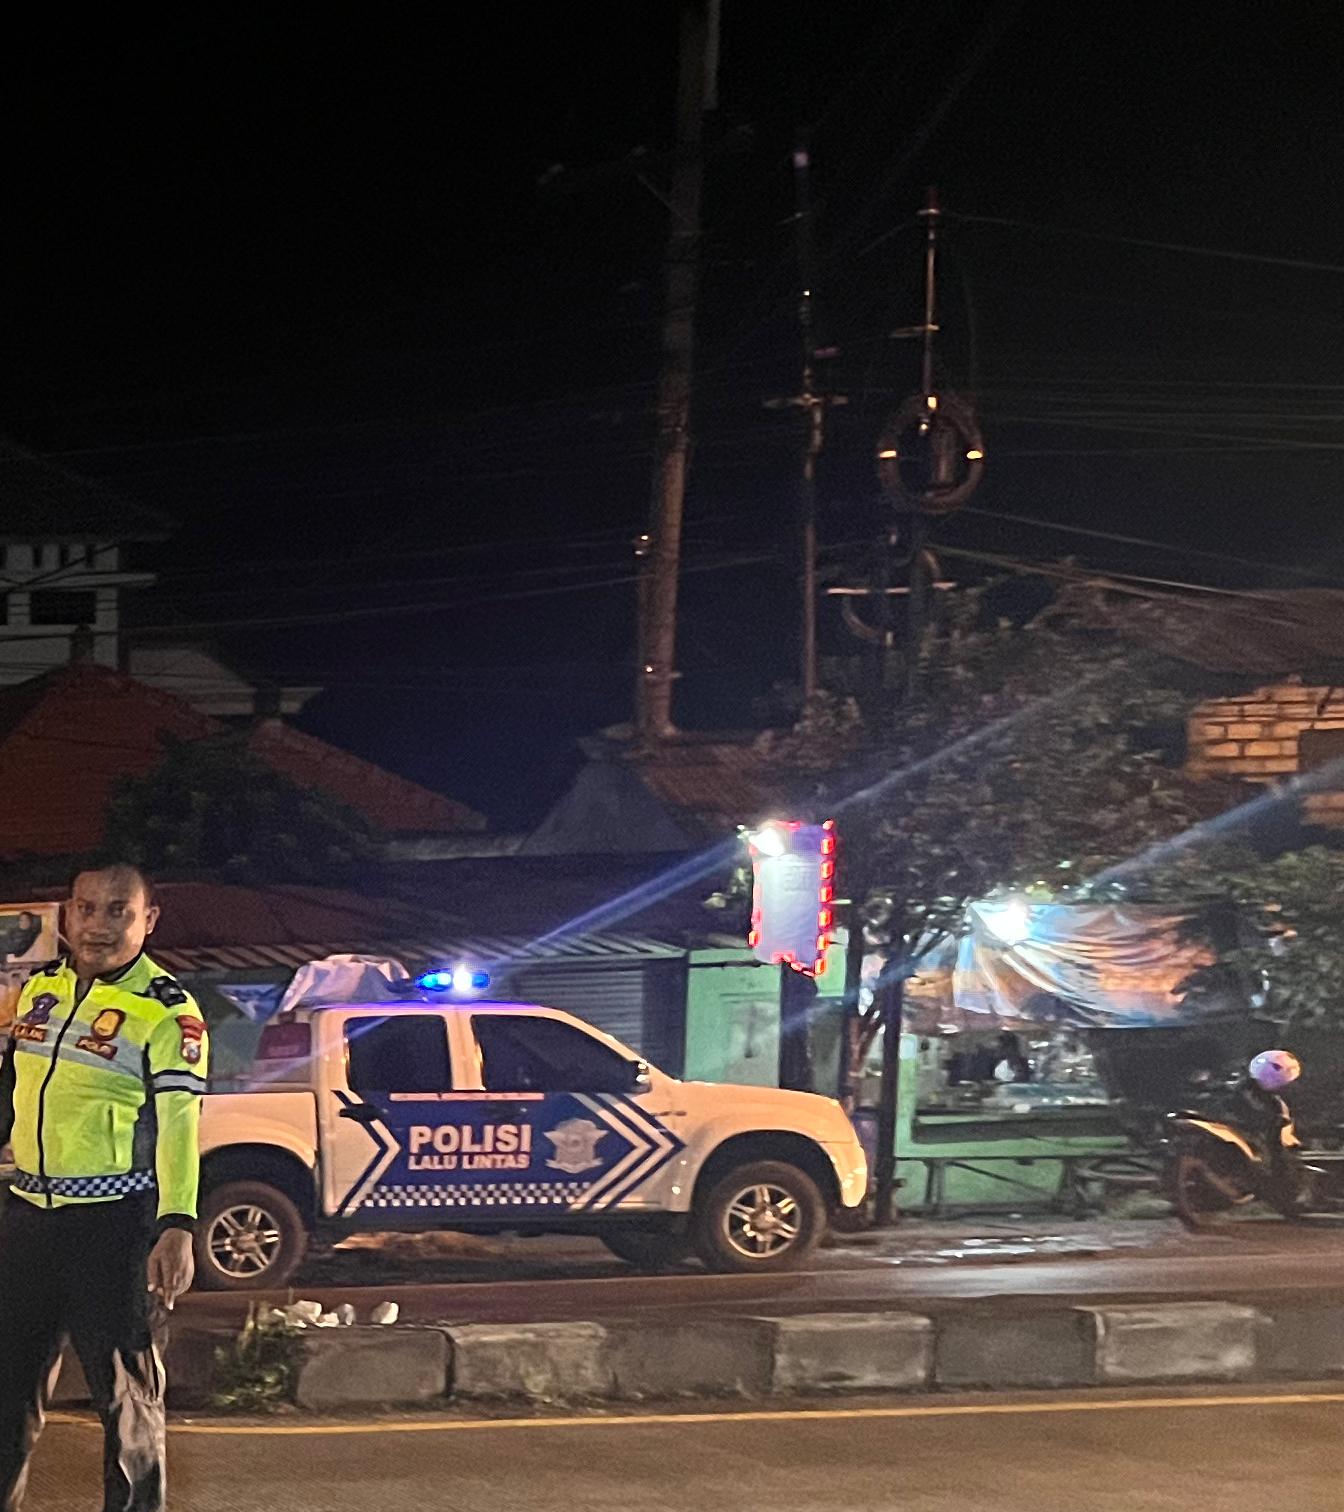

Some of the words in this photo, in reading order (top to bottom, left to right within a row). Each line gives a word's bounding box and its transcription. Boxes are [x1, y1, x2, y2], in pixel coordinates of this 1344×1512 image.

[409, 1124, 532, 1154] POLISI
[408, 1154, 458, 1170] LALU
[462, 1154, 530, 1170] LINTAS
